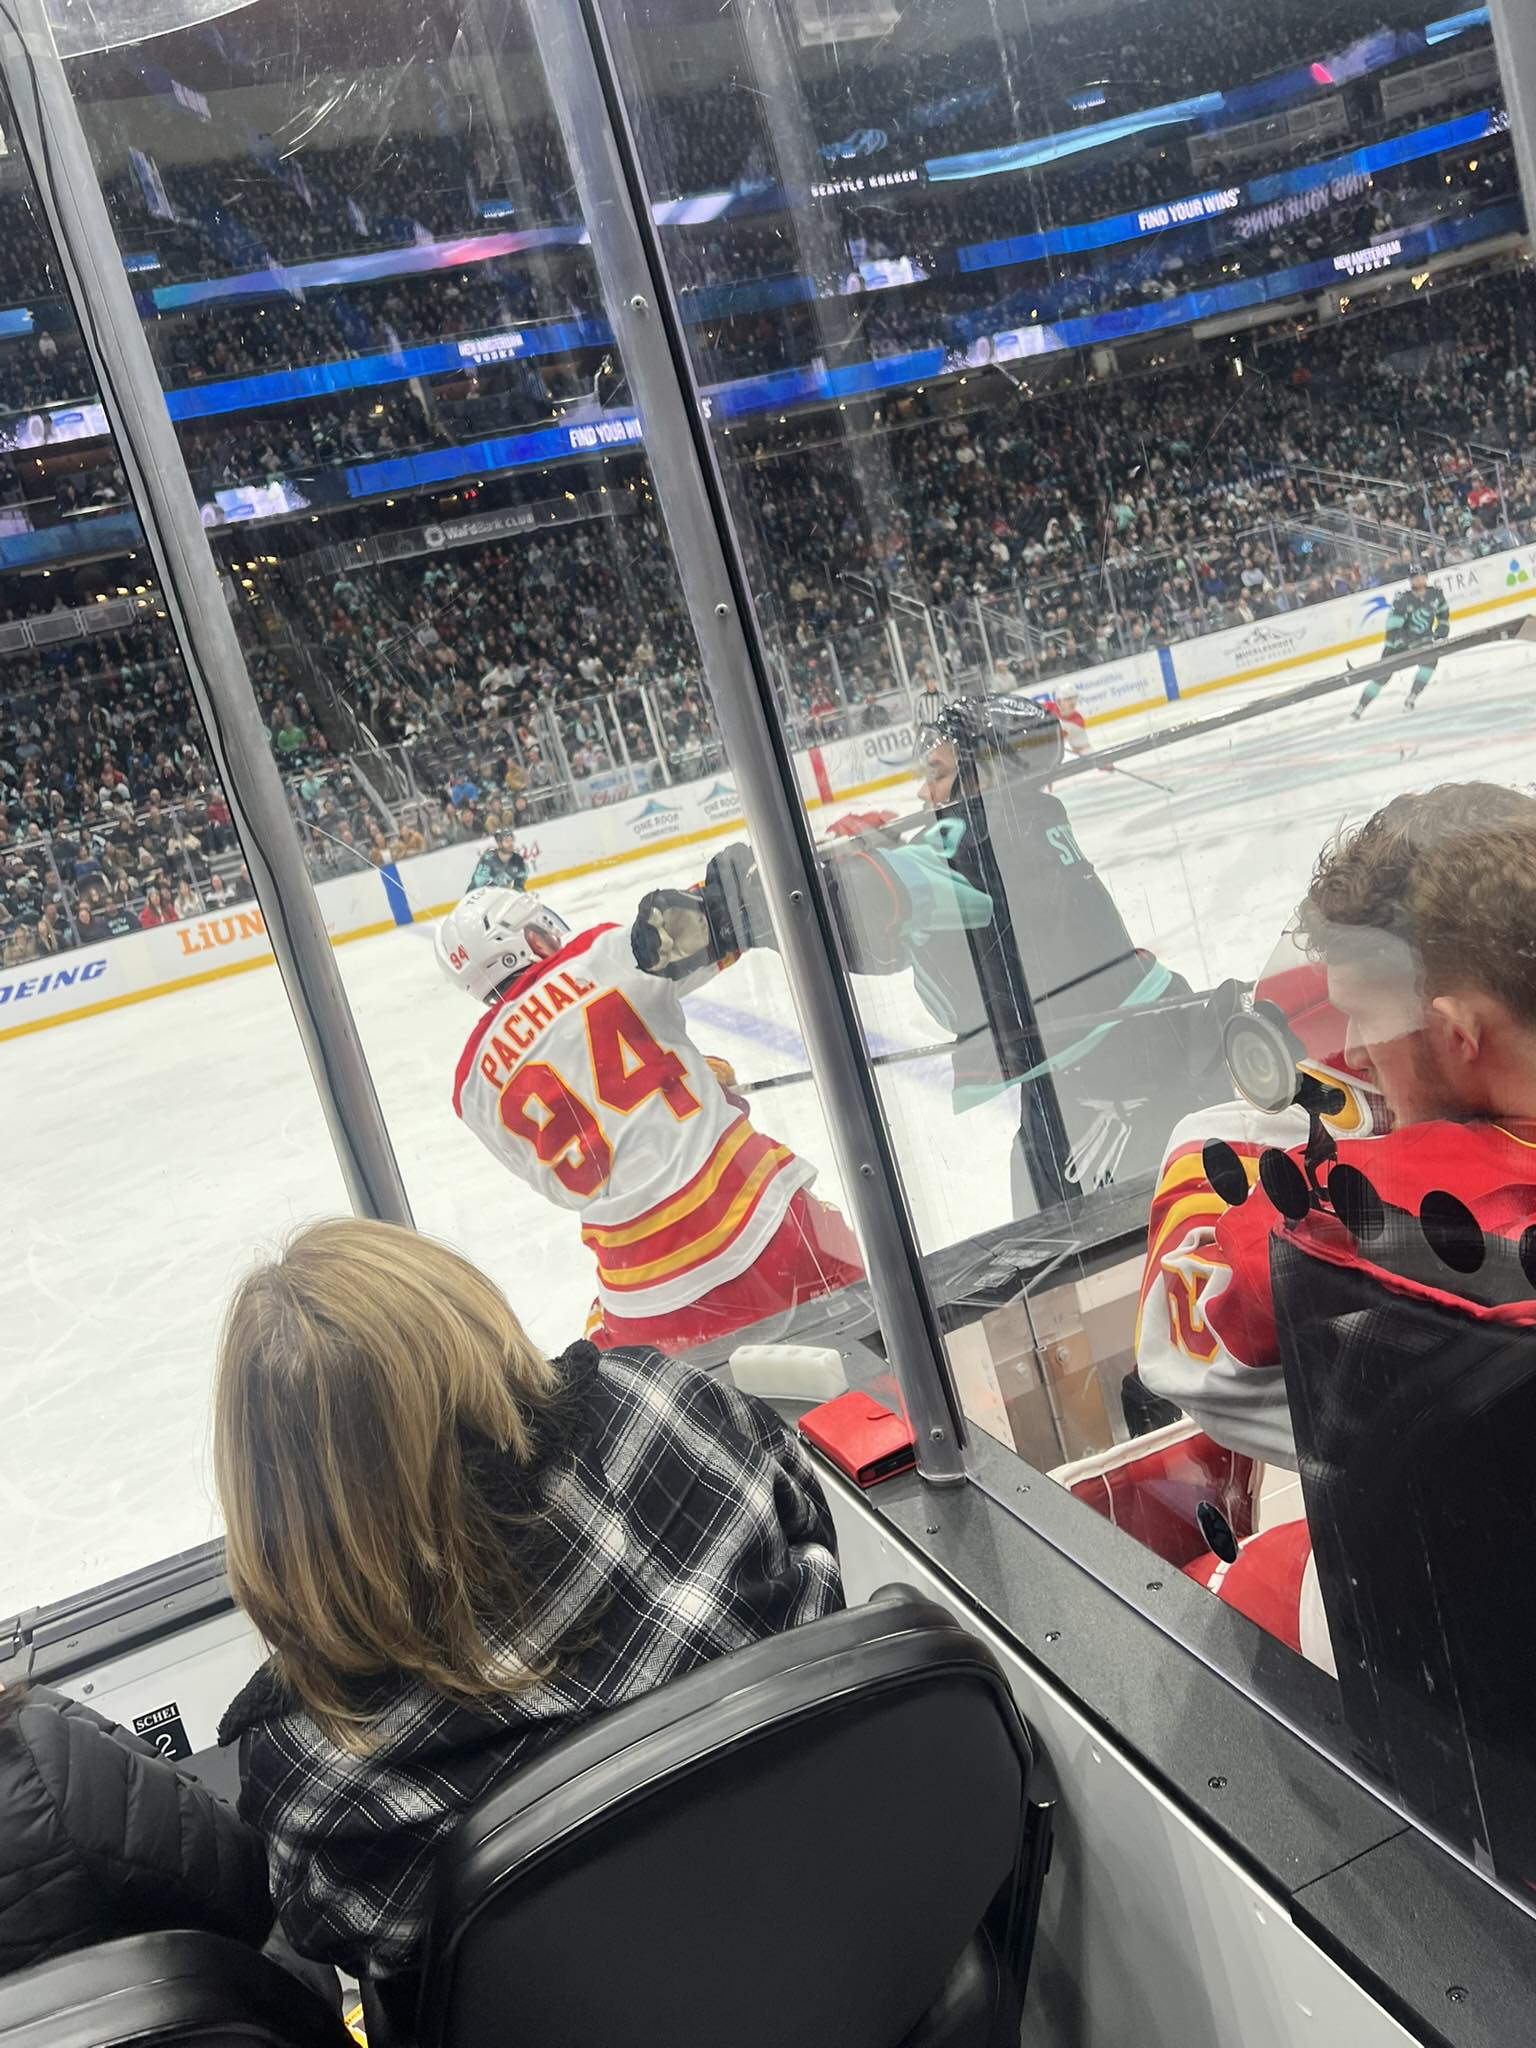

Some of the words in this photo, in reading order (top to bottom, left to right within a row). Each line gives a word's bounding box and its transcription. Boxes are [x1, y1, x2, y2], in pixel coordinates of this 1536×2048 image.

[811, 178, 865, 197] SEATTLE
[869, 169, 918, 188] KRAKEN
[1138, 207, 1169, 231] FIND
[1168, 198, 1204, 222] YOUR
[569, 425, 598, 448] FIND
[595, 420, 627, 443] YOUR
[864, 728, 913, 758] ama
[177, 910, 265, 955] LiUN
[449, 943, 471, 971] 94
[479, 971, 597, 1090] PACHAL
[498, 985, 704, 1198] 94
[155, 1733, 177, 1757] 2
